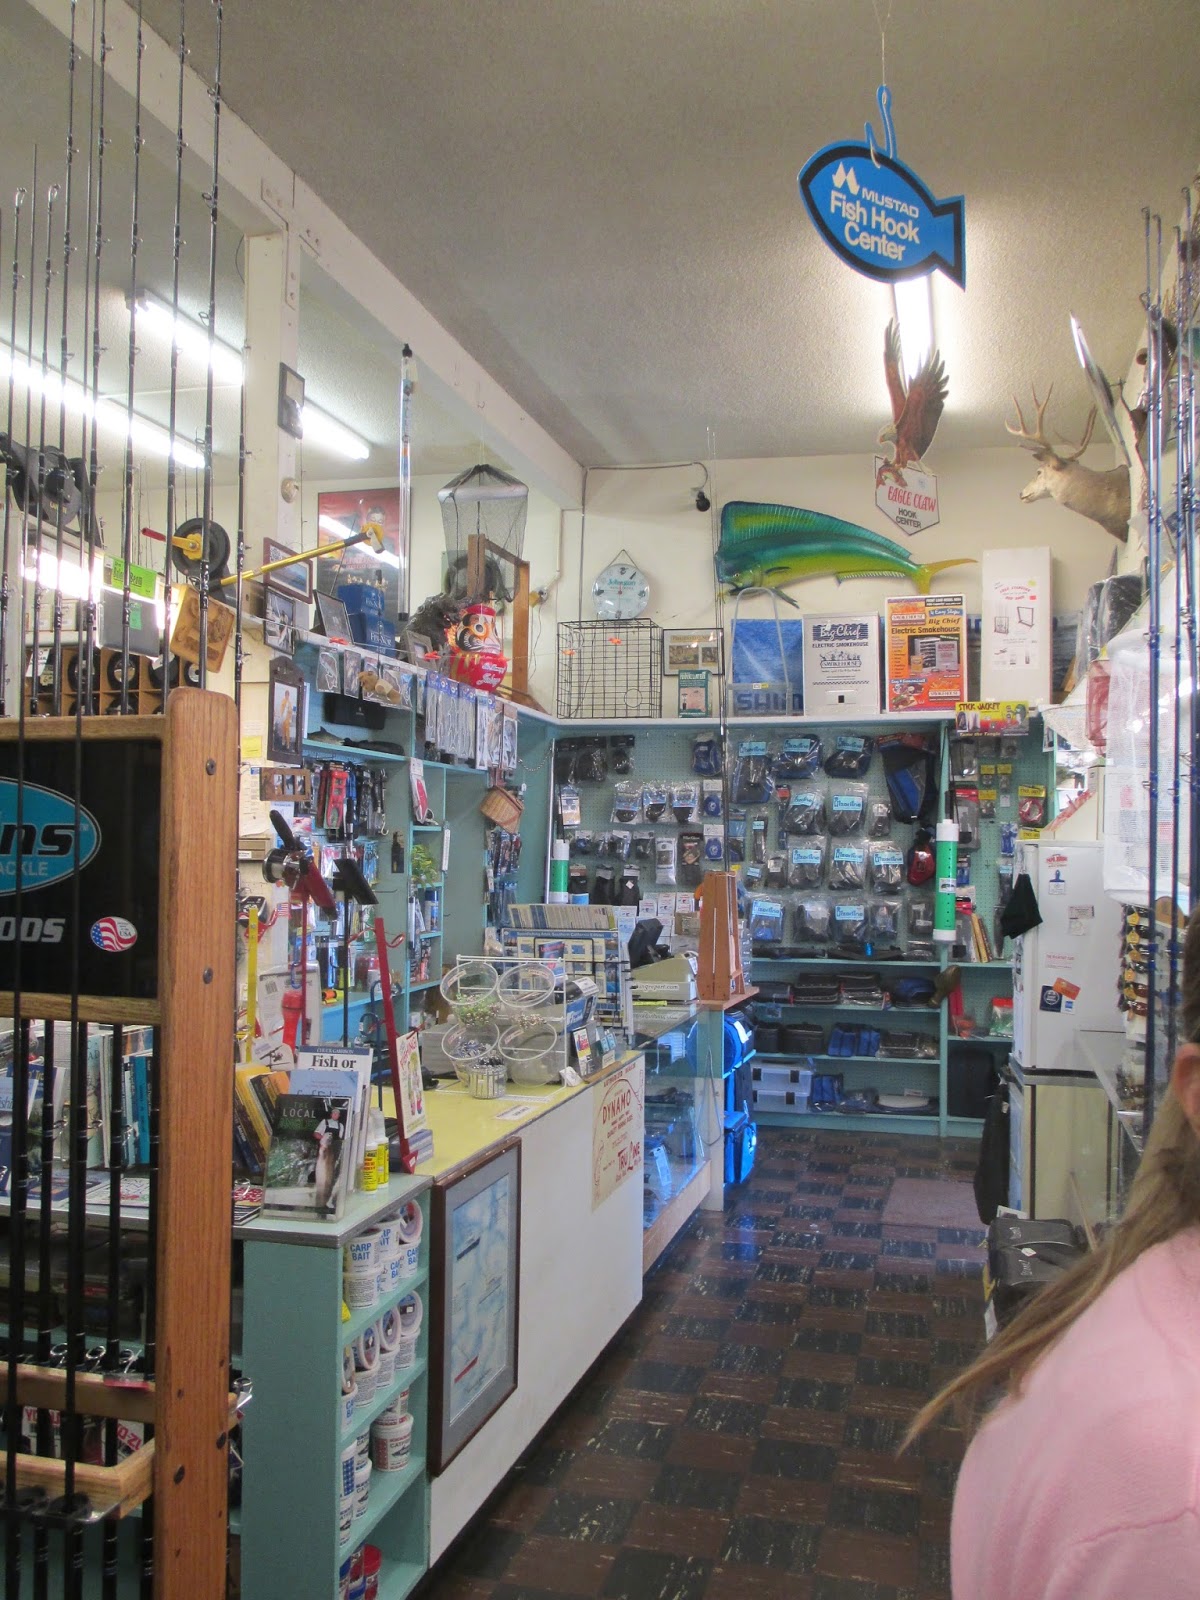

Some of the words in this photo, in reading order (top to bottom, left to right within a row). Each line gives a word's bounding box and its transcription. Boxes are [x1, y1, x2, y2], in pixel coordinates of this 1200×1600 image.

[862, 187, 919, 219] MUSTAD
[830, 190, 867, 226] Fish
[871, 207, 920, 244] Hook
[844, 221, 906, 261] Center
[888, 485, 912, 506] EAGLE
[913, 494, 937, 512] CLAW
[898, 508, 917, 519] HOOK
[896, 516, 922, 529] CENTER
[942, 617, 960, 625] Chief
[820, 625, 835, 640] Big
[836, 624, 861, 639] Chief
[891, 627, 916, 635] Electric
[918, 626, 960, 634] Smokehouse
[959, 703, 975, 711] STICK
[977, 702, 1001, 710] JACKET
[311, 1054, 338, 1068] Fish
[341, 1059, 357, 1069] or
[282, 1108, 316, 1119] LOCAL
[602, 1089, 631, 1125] DYNAMO
[350, 1242, 372, 1253] CARP
[351, 1252, 371, 1261] BAIT
